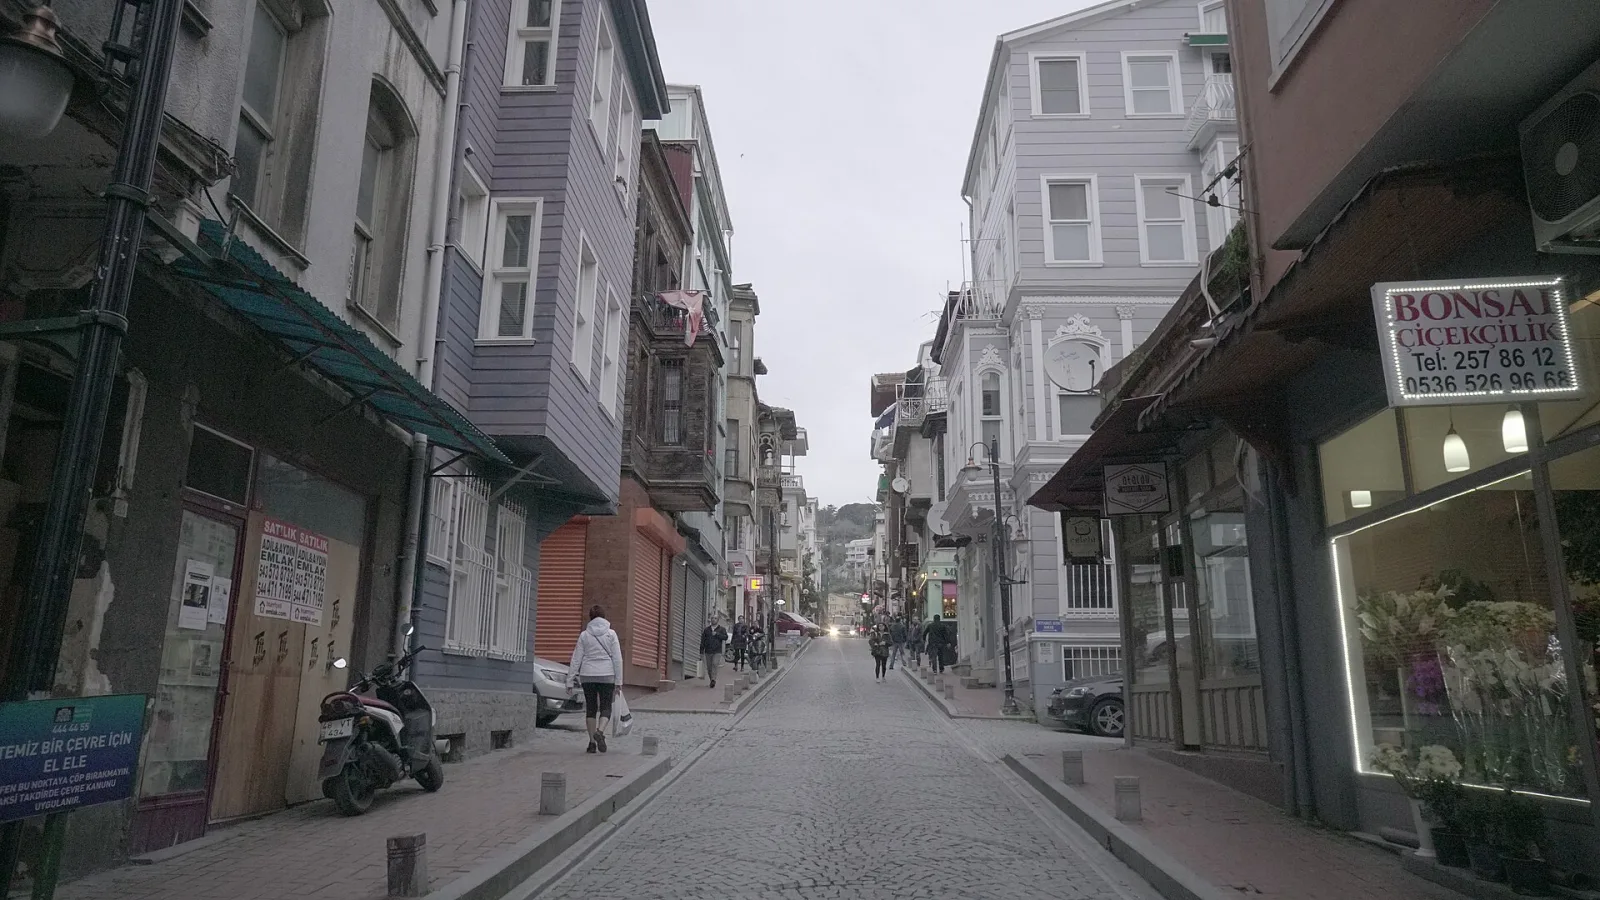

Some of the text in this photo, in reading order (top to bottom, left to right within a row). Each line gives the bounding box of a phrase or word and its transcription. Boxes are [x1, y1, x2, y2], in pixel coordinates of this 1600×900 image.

[1393, 288, 1558, 322] BONSAI
[1397, 319, 1563, 352] ÇİÇEKÇİLİK
[1411, 347, 1556, 372] Tel: 257 86 12
[1405, 370, 1570, 394] 0536 526 96 68
[264, 520, 297, 541] SATILIK
[299, 532, 328, 552] SATILIK
[261, 550, 294, 567] EMLAK
[297, 560, 325, 577] EMLAK
[52, 722, 91, 733] 444 44 55
[0, 731, 132, 759] TEMİZ BİR ÇEVRE İÇİN
[43, 755, 88, 773] EL ELE
[18, 782, 30, 791] BU
[31, 776, 68, 789] NOKTAYA
[69, 773, 84, 785] ÇÖP
[85, 767, 130, 781] BIRAKMAYIN.
[20, 788, 59, 802] TAKDİRDE
[60, 784, 85, 796] ÇEVRE
[86, 779, 116, 791] KANUNU
[34, 796, 81, 811] UYGULANIR.
